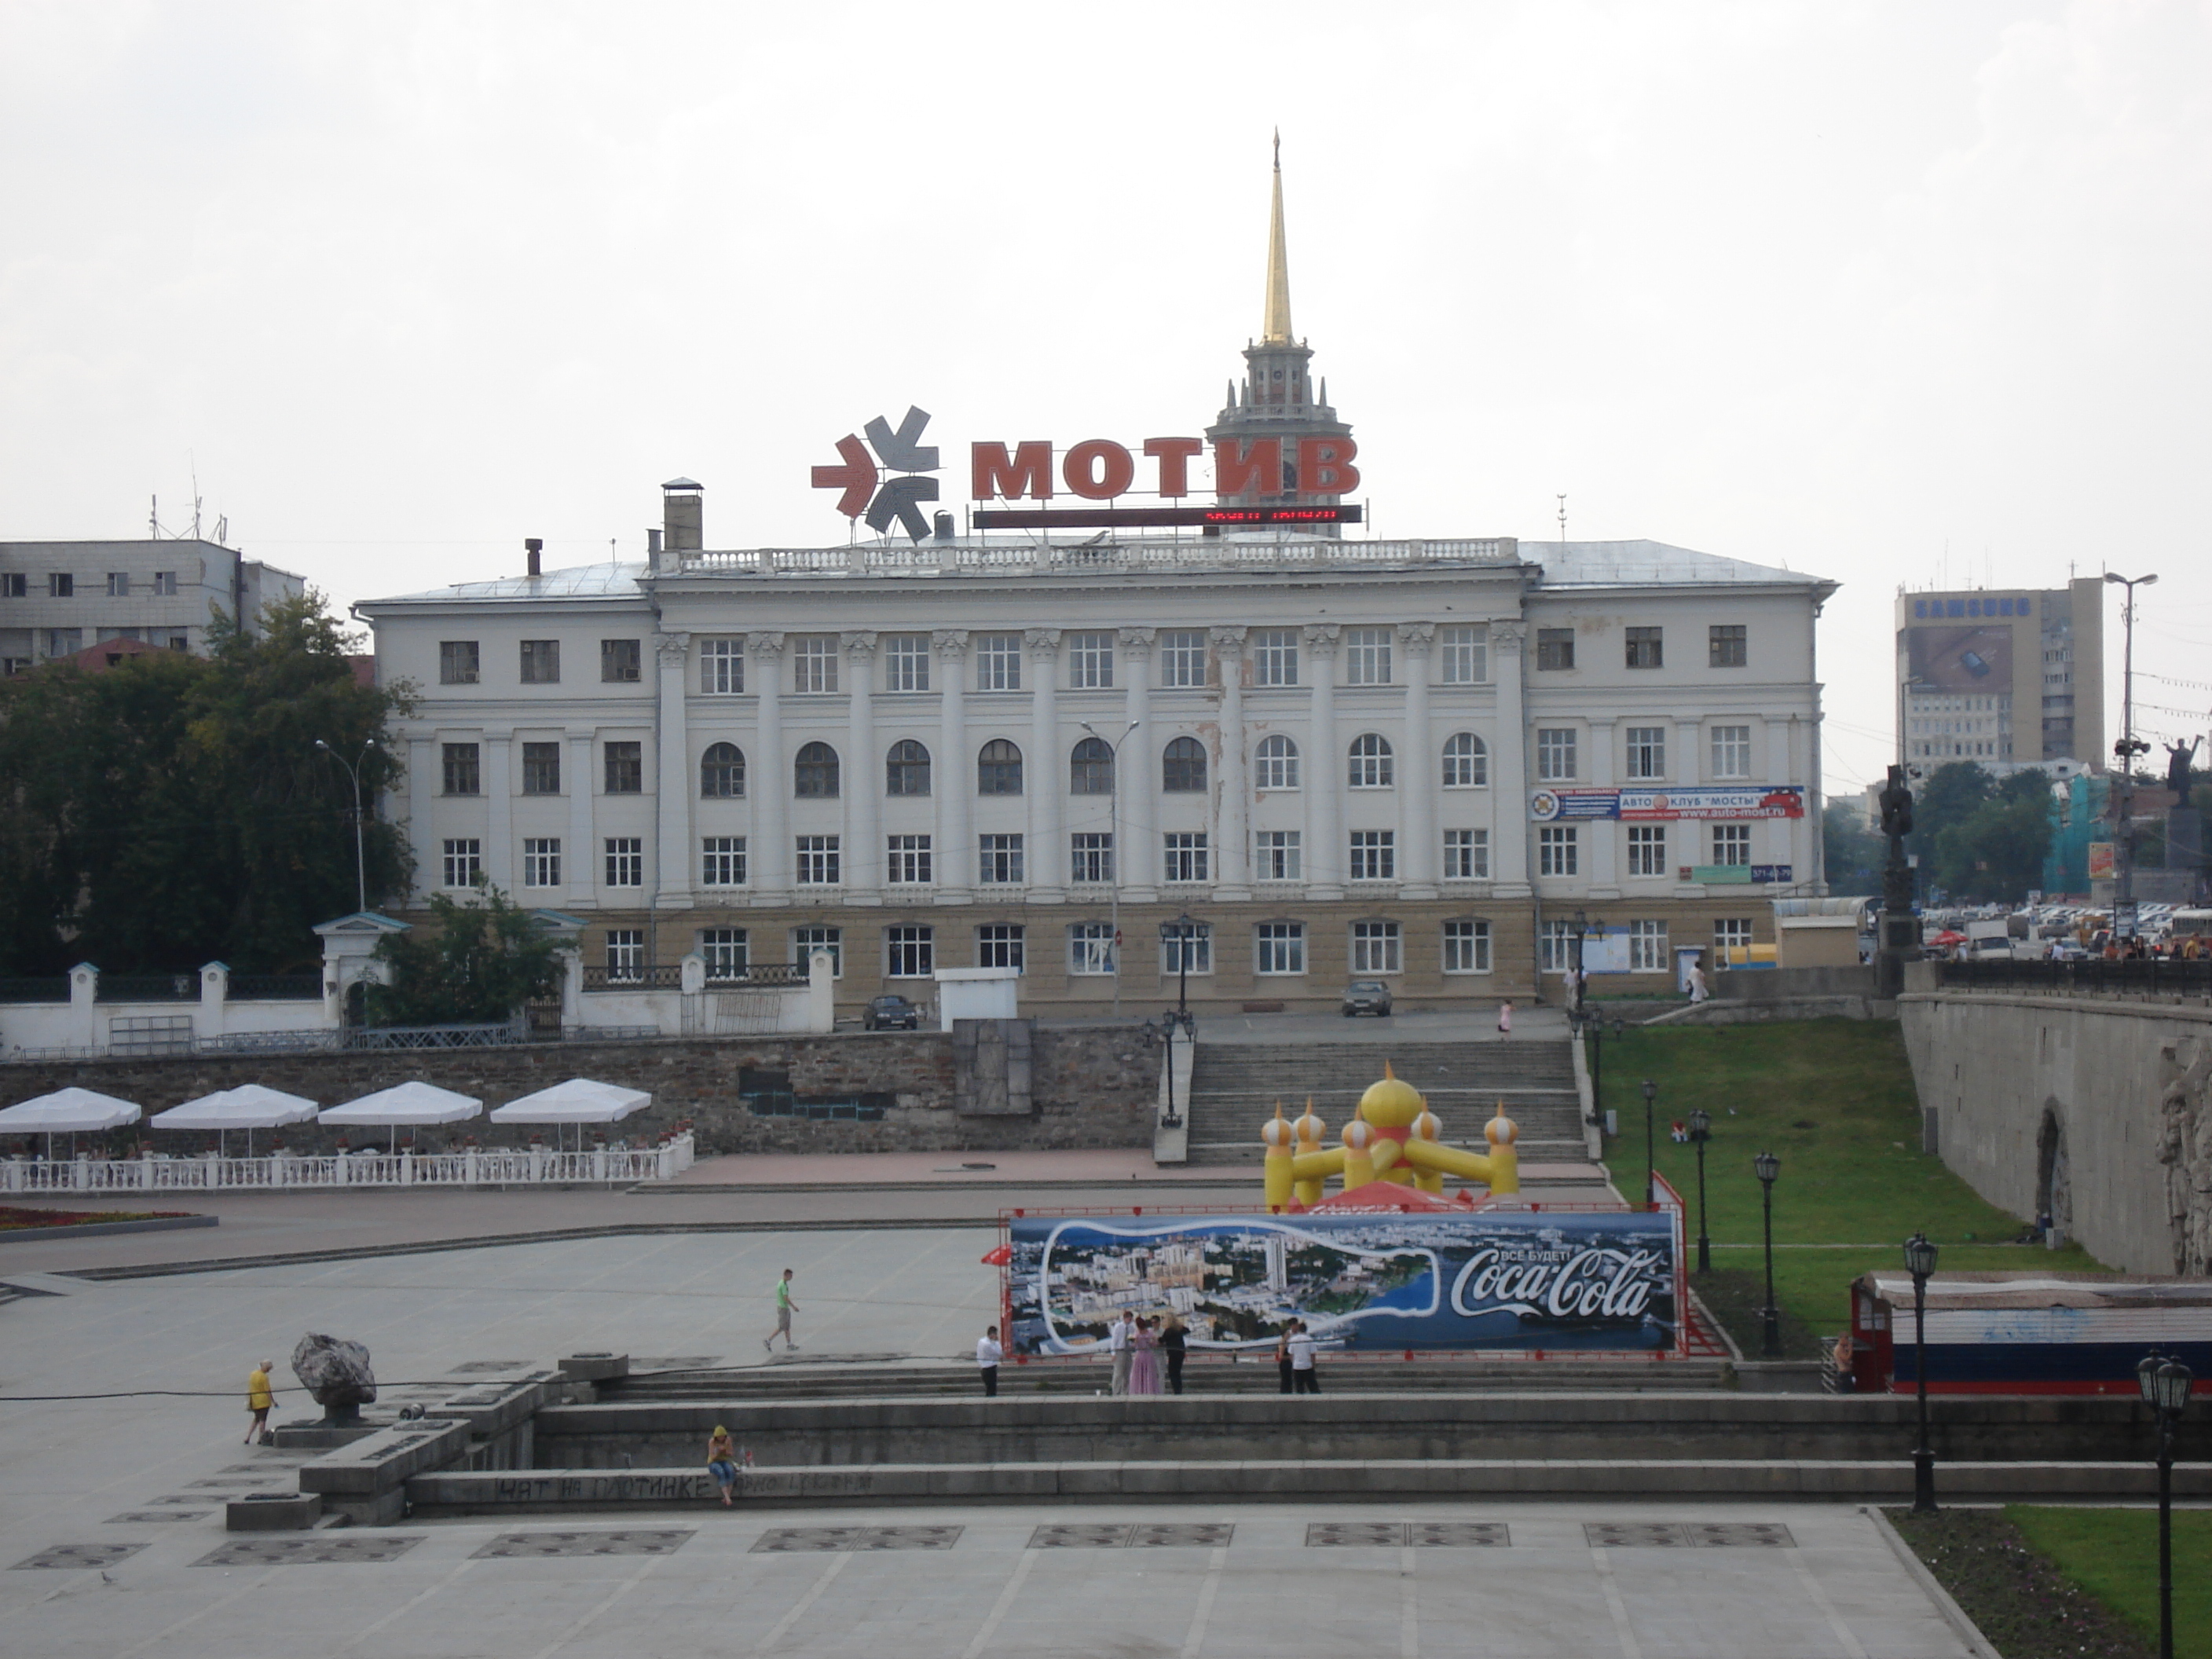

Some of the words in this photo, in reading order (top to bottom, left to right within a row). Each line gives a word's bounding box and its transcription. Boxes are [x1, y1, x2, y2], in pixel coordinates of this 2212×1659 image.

[972, 436, 1361, 500] МОТИВ
[1915, 597, 2031, 619] SAMSUNG
[1622, 797, 1652, 807] АВТО
[1671, 797, 1701, 807] КЛУБ
[1679, 805, 1785, 819] www.auto-most.ru
[1451, 1247, 1663, 1317] Coca-Cola
